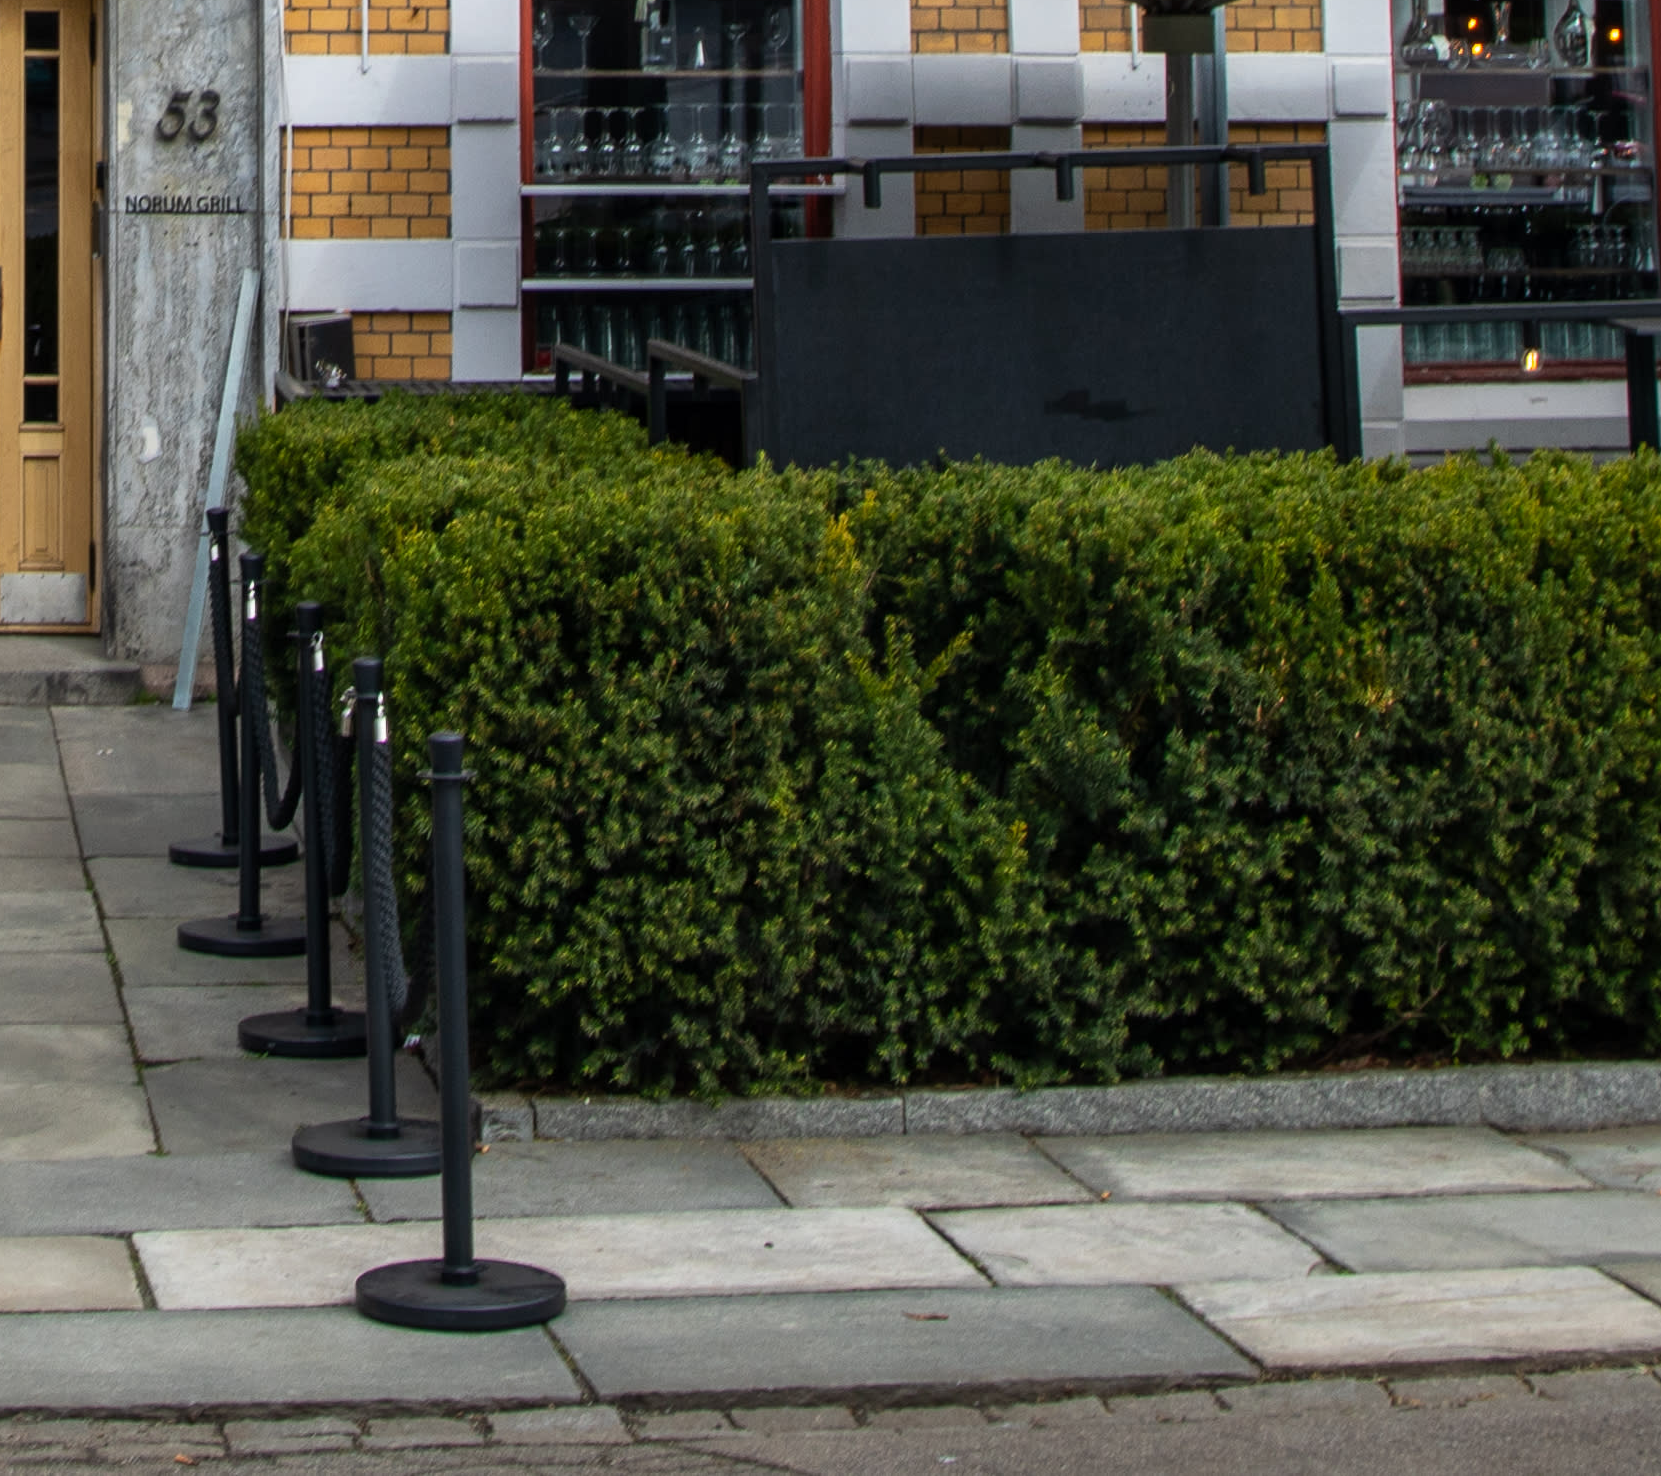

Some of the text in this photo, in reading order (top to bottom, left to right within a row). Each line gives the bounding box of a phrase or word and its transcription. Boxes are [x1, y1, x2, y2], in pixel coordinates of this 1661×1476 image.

[156, 90, 220, 142] 53
[125, 195, 246, 214] NORUM GRILL
